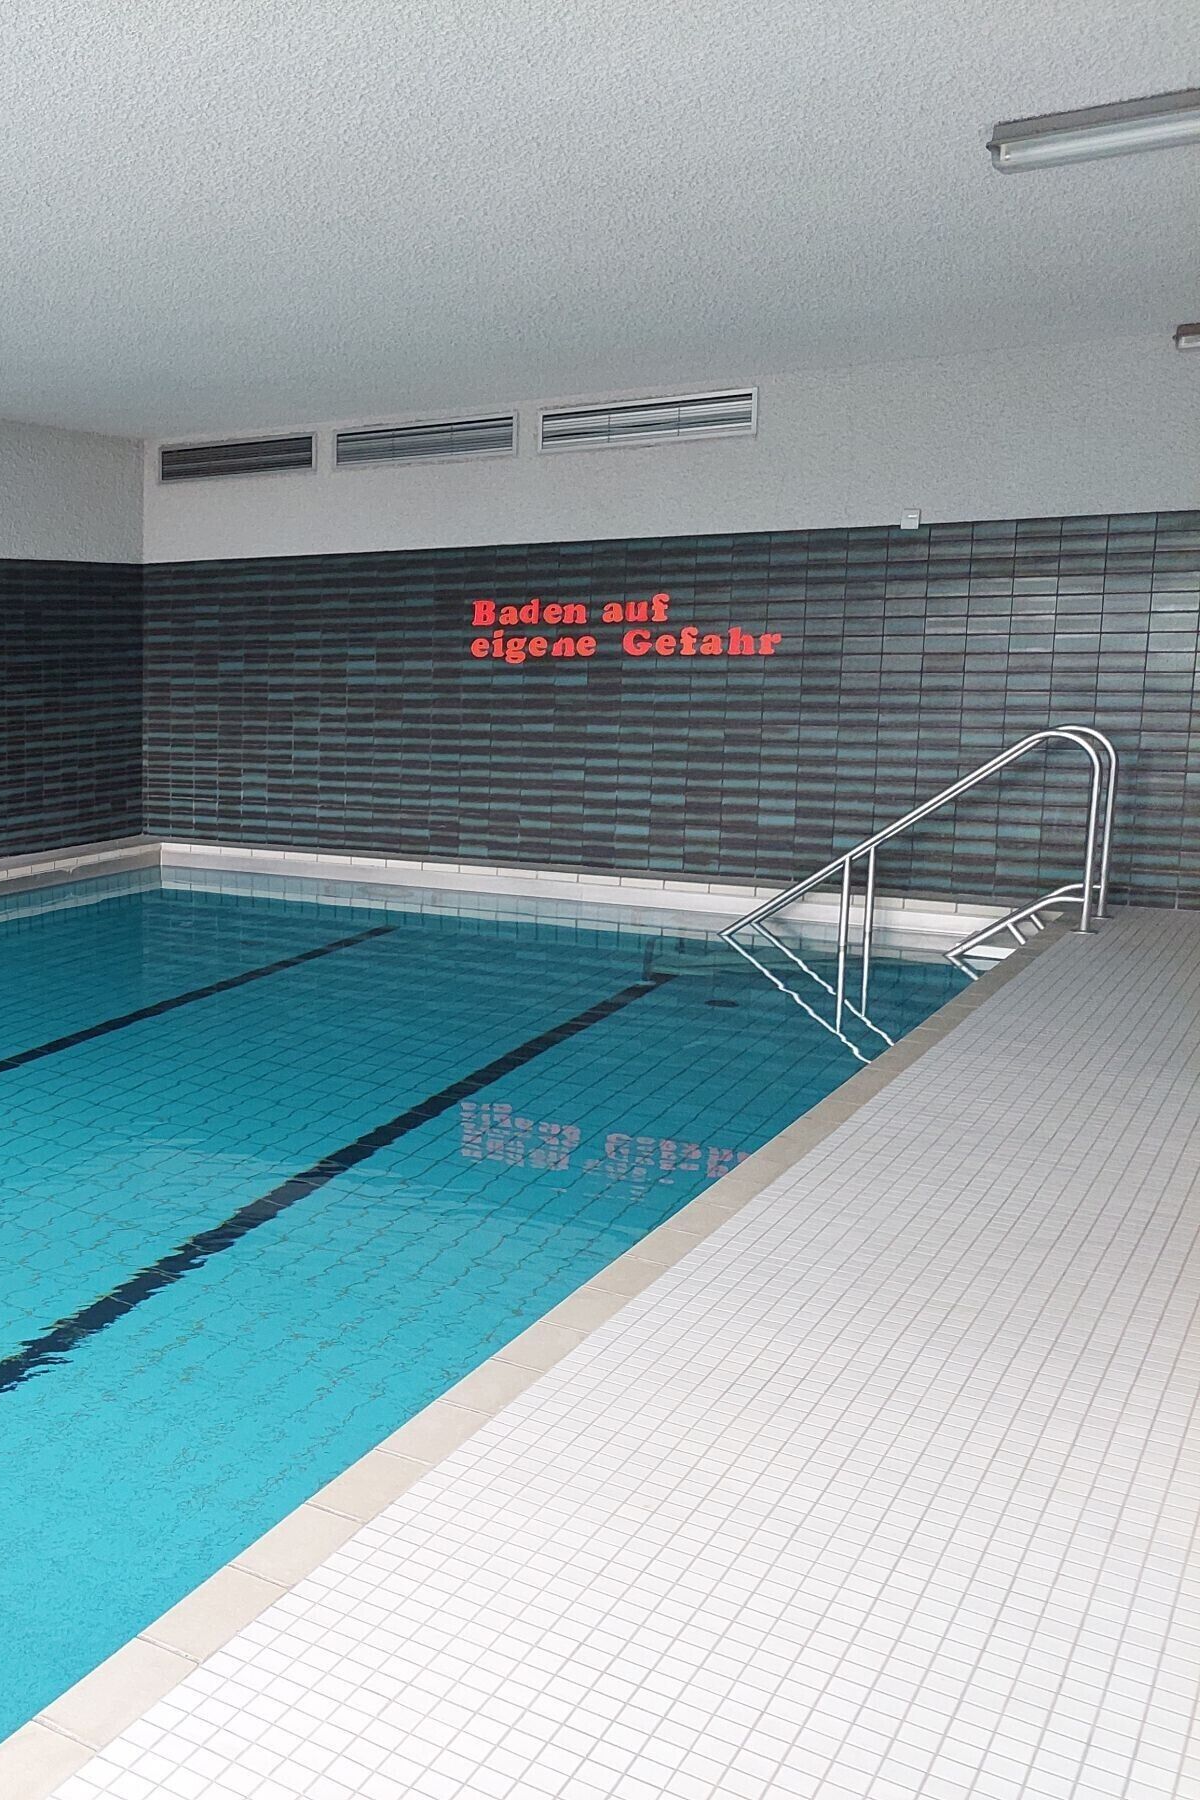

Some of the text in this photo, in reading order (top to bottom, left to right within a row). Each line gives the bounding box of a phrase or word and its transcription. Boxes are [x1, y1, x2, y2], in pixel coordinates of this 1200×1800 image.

[471, 593, 670, 627] Baden auf
[470, 626, 782, 665] eigene Gefahr
